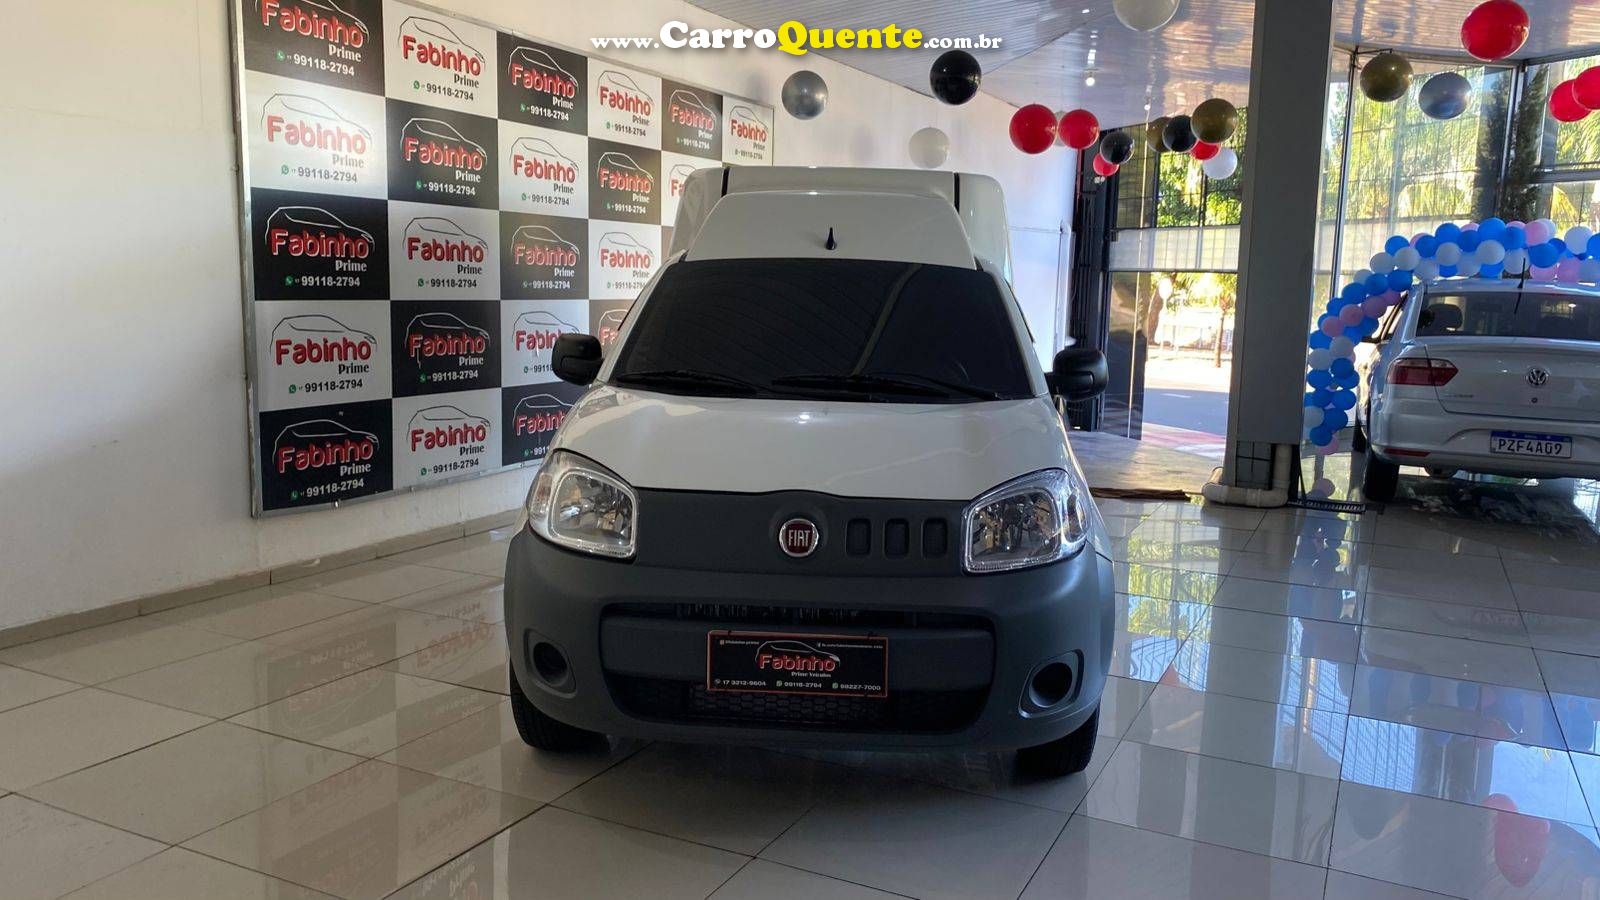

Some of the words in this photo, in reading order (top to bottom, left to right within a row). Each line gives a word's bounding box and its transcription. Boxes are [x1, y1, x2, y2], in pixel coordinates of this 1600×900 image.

[261, 0, 364, 48] Fabinho
[328, 43, 362, 62] Prime
[402, 35, 481, 76] Fabinho
[293, 53, 355, 76] 99118-2794
[453, 73, 480, 89] Prime
[511, 63, 575, 98] Fabinho
[426, 83, 474, 101] 99118-2794
[600, 85, 651, 117] Fabinho
[552, 96, 574, 109] Prime
[530, 105, 569, 121] 99118-2794
[671, 104, 714, 131] Fabinho
[266, 115, 367, 155] Fabinho
[730, 119, 767, 143] Fabinho
[332, 153, 364, 168] Prime
[404, 136, 483, 171] Fabinho
[297, 166, 358, 183] 99118-2794
[455, 170, 481, 183] Prime
[513, 154, 576, 184] Fabinho
[428, 182, 476, 196] 99118-2794
[553, 183, 574, 194] Prime
[600, 166, 651, 194] Fabinho
[531, 194, 570, 206] 99118-2794
[271, 228, 369, 259] Fabinho
[407, 236, 484, 263] Fabinho
[514, 241, 577, 267] Fabinho
[600, 248, 651, 269] Fabinho
[335, 259, 367, 272] Prime
[457, 263, 482, 275] Prime
[554, 268, 575, 277] Prime
[301, 275, 361, 287] 99118-2794
[430, 278, 477, 288] 99118-2794
[532, 280, 571, 289] 99118-2794
[275, 337, 372, 365] Fabinho
[409, 333, 486, 358] Fabinho
[338, 362, 370, 375] Prime
[458, 354, 484, 366] Prime
[432, 370, 479, 382] 99118-2794
[304, 378, 363, 393] 99118-2794
[410, 423, 487, 452] Fabinho
[278, 438, 374, 474] Fabinho
[459, 443, 485, 457] Prime
[340, 463, 372, 477] Prime
[433, 458, 479, 474] 99118-2794
[306, 478, 365, 497] 99118-2794
[788, 529, 811, 547] FIAT
[759, 653, 836, 672] Fabinho
